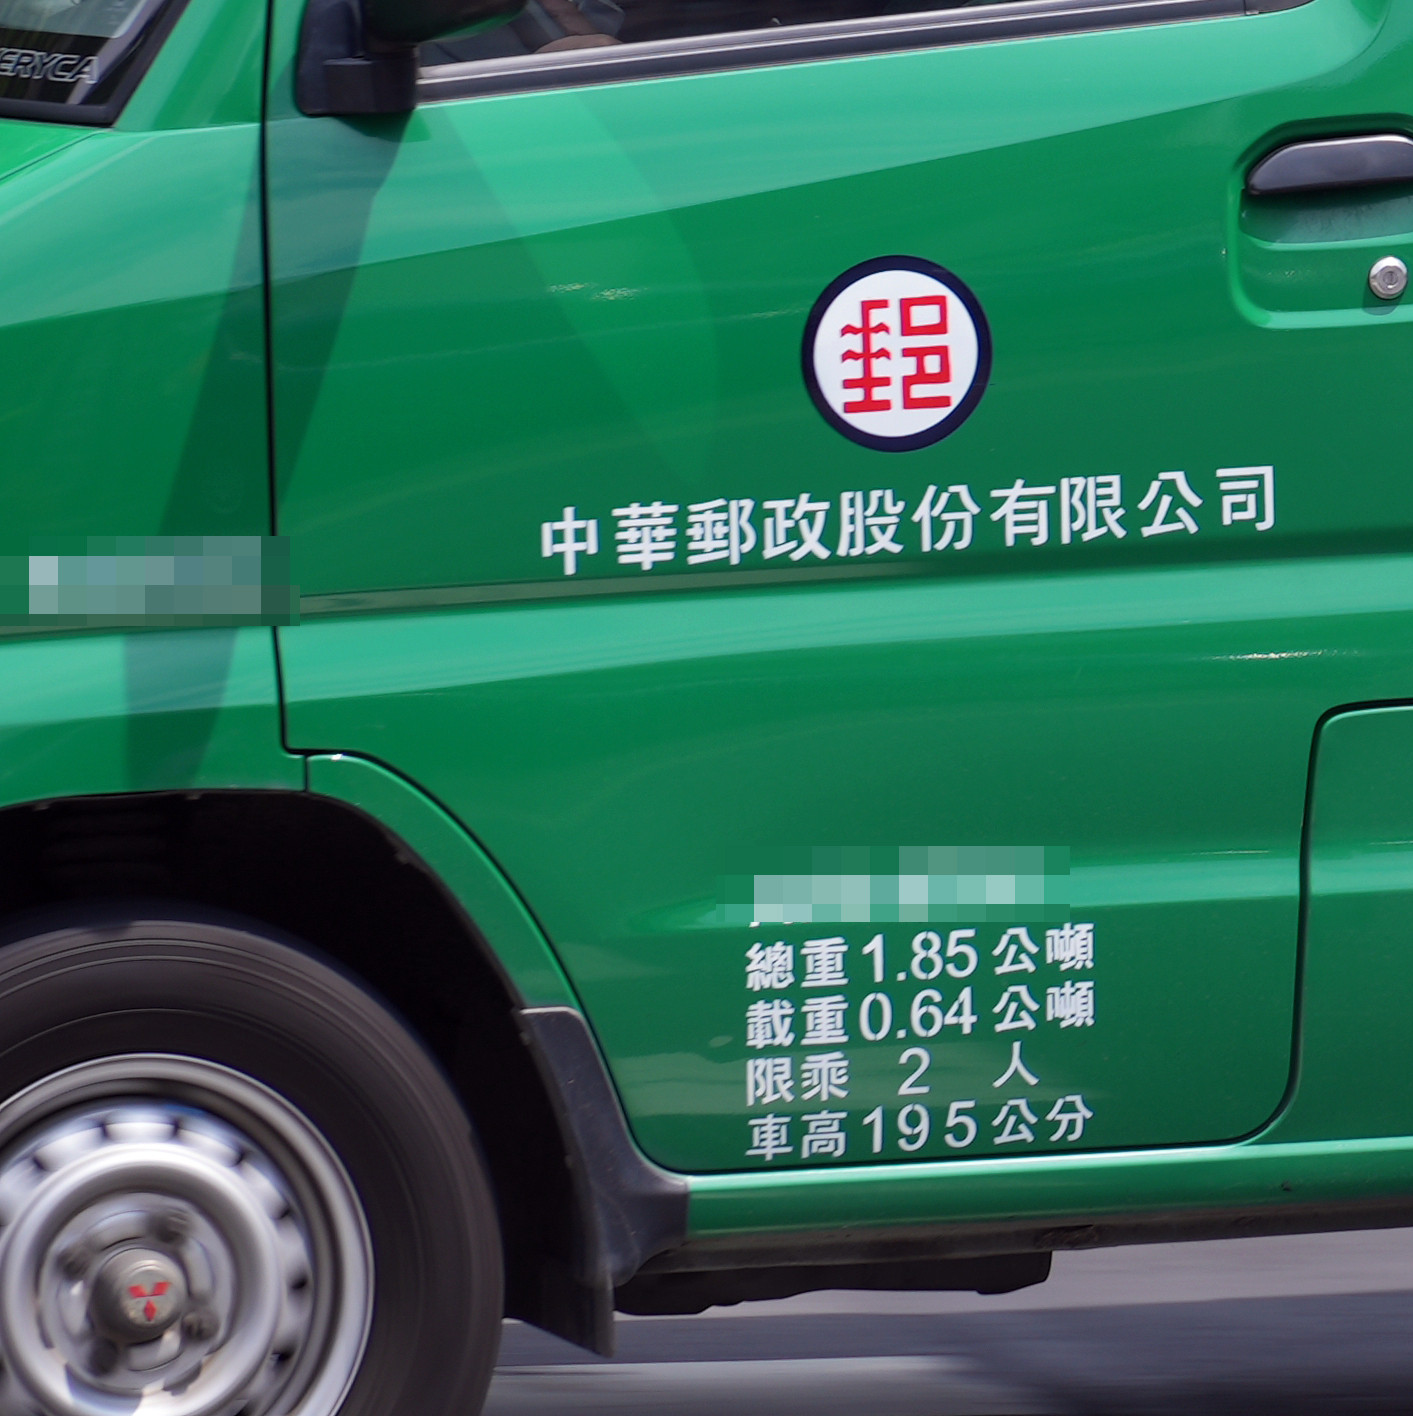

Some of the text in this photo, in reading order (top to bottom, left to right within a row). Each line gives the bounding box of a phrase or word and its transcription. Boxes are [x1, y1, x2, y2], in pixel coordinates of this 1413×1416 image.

[0, 47, 99, 85] ERYCA
[840, 295, 953, 415] 郵
[541, 465, 1276, 576] 中華郵政股份有限公司
